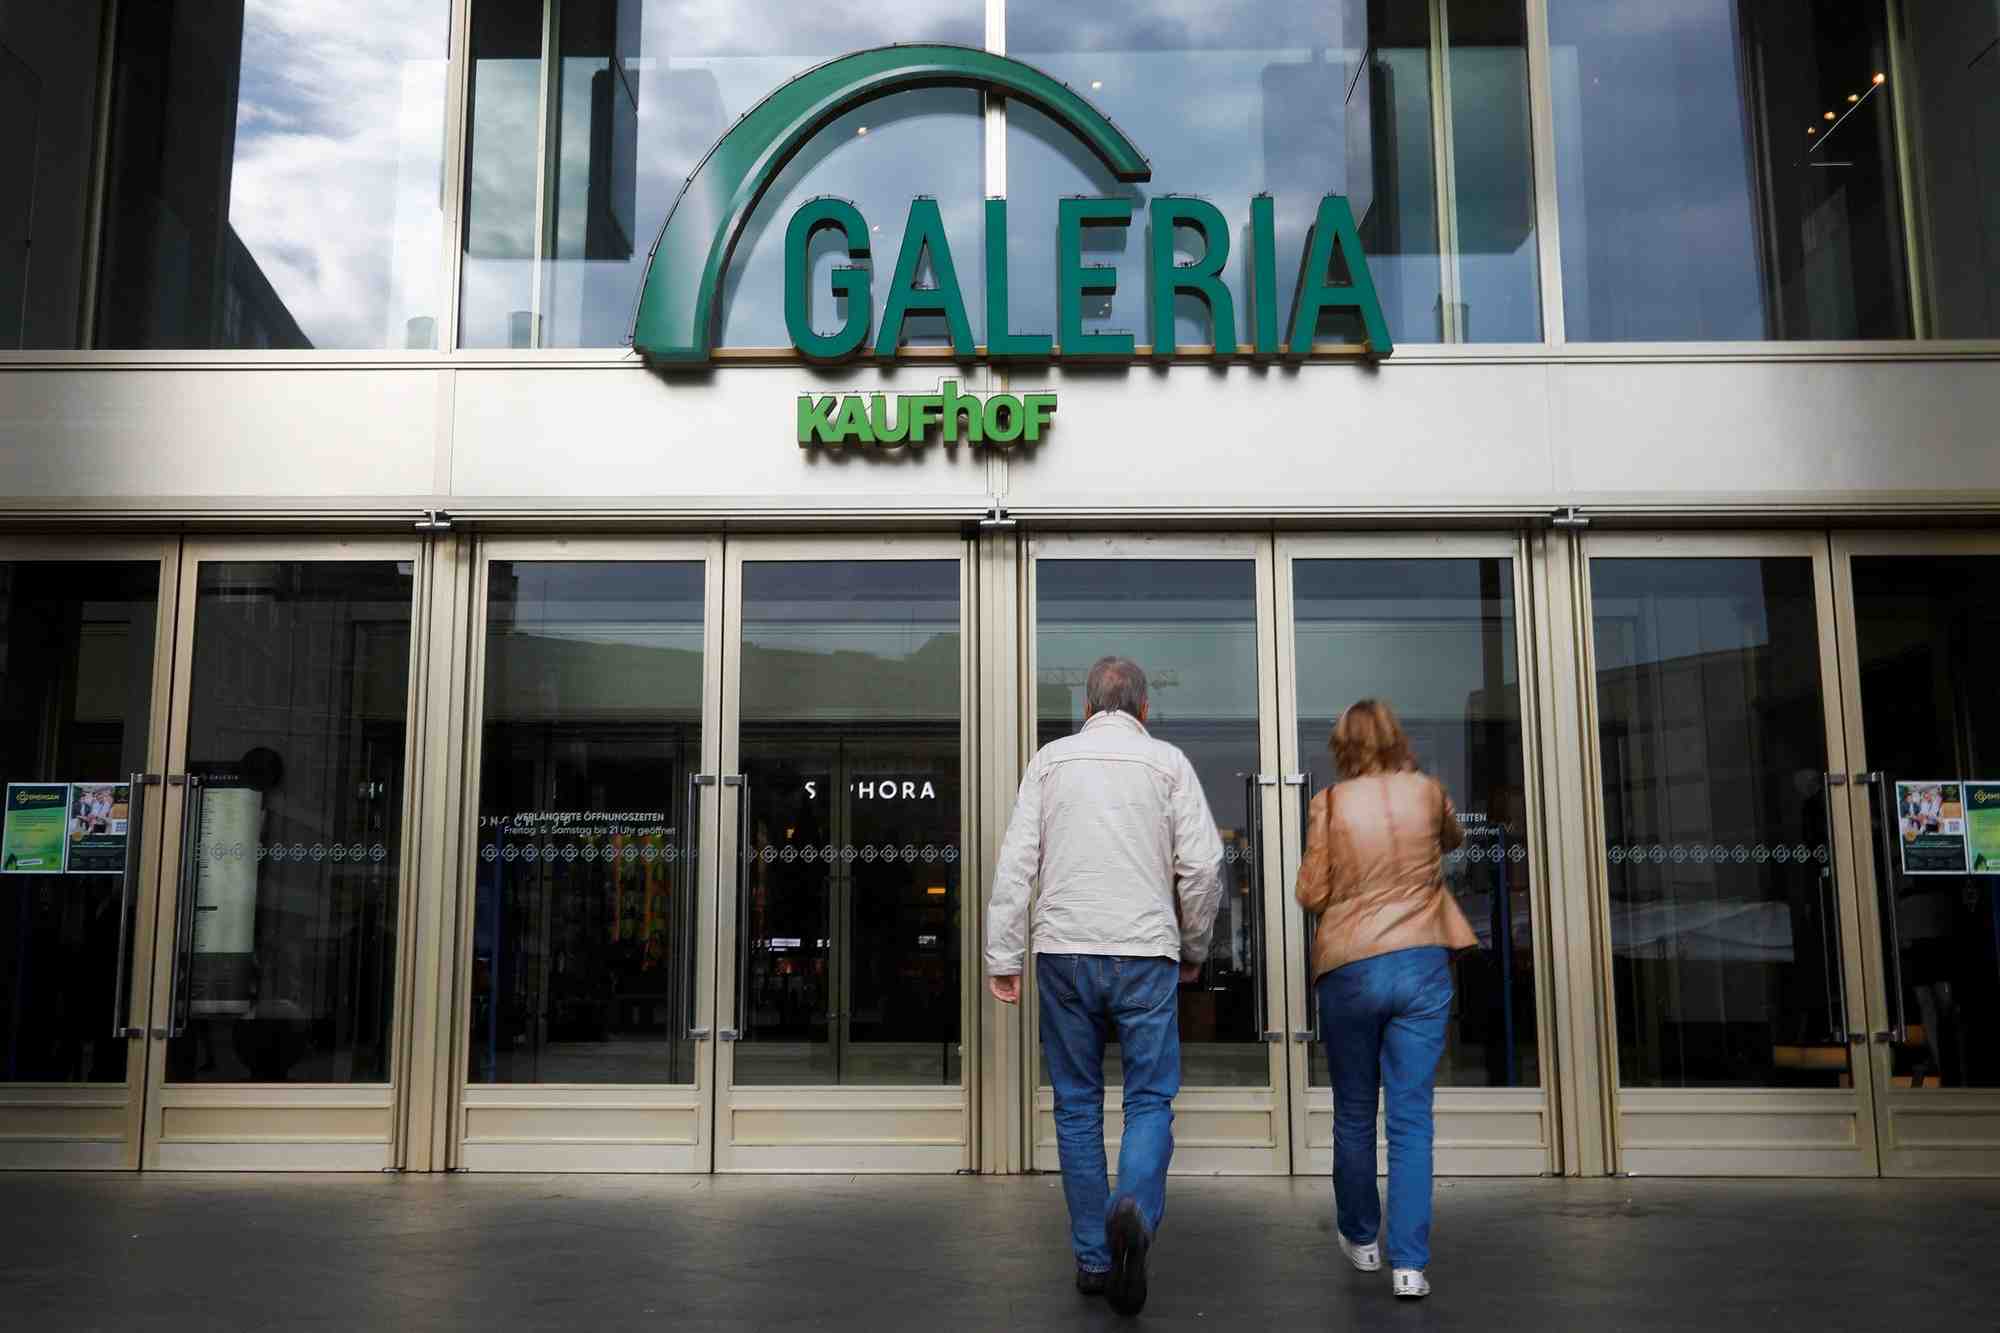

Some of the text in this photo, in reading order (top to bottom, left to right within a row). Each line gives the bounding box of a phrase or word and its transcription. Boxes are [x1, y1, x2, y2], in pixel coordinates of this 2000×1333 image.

[784, 196, 1394, 360] GALERIA
[804, 781, 935, 799] SHORA
[583, 810, 664, 822] ÖFFNUNGSZEITEN
[504, 825, 536, 836] Freitag
[551, 825, 592, 836] Samstag
[594, 825, 607, 835] bis
[608, 825, 618, 835] 21
[620, 825, 634, 835] Uhr
